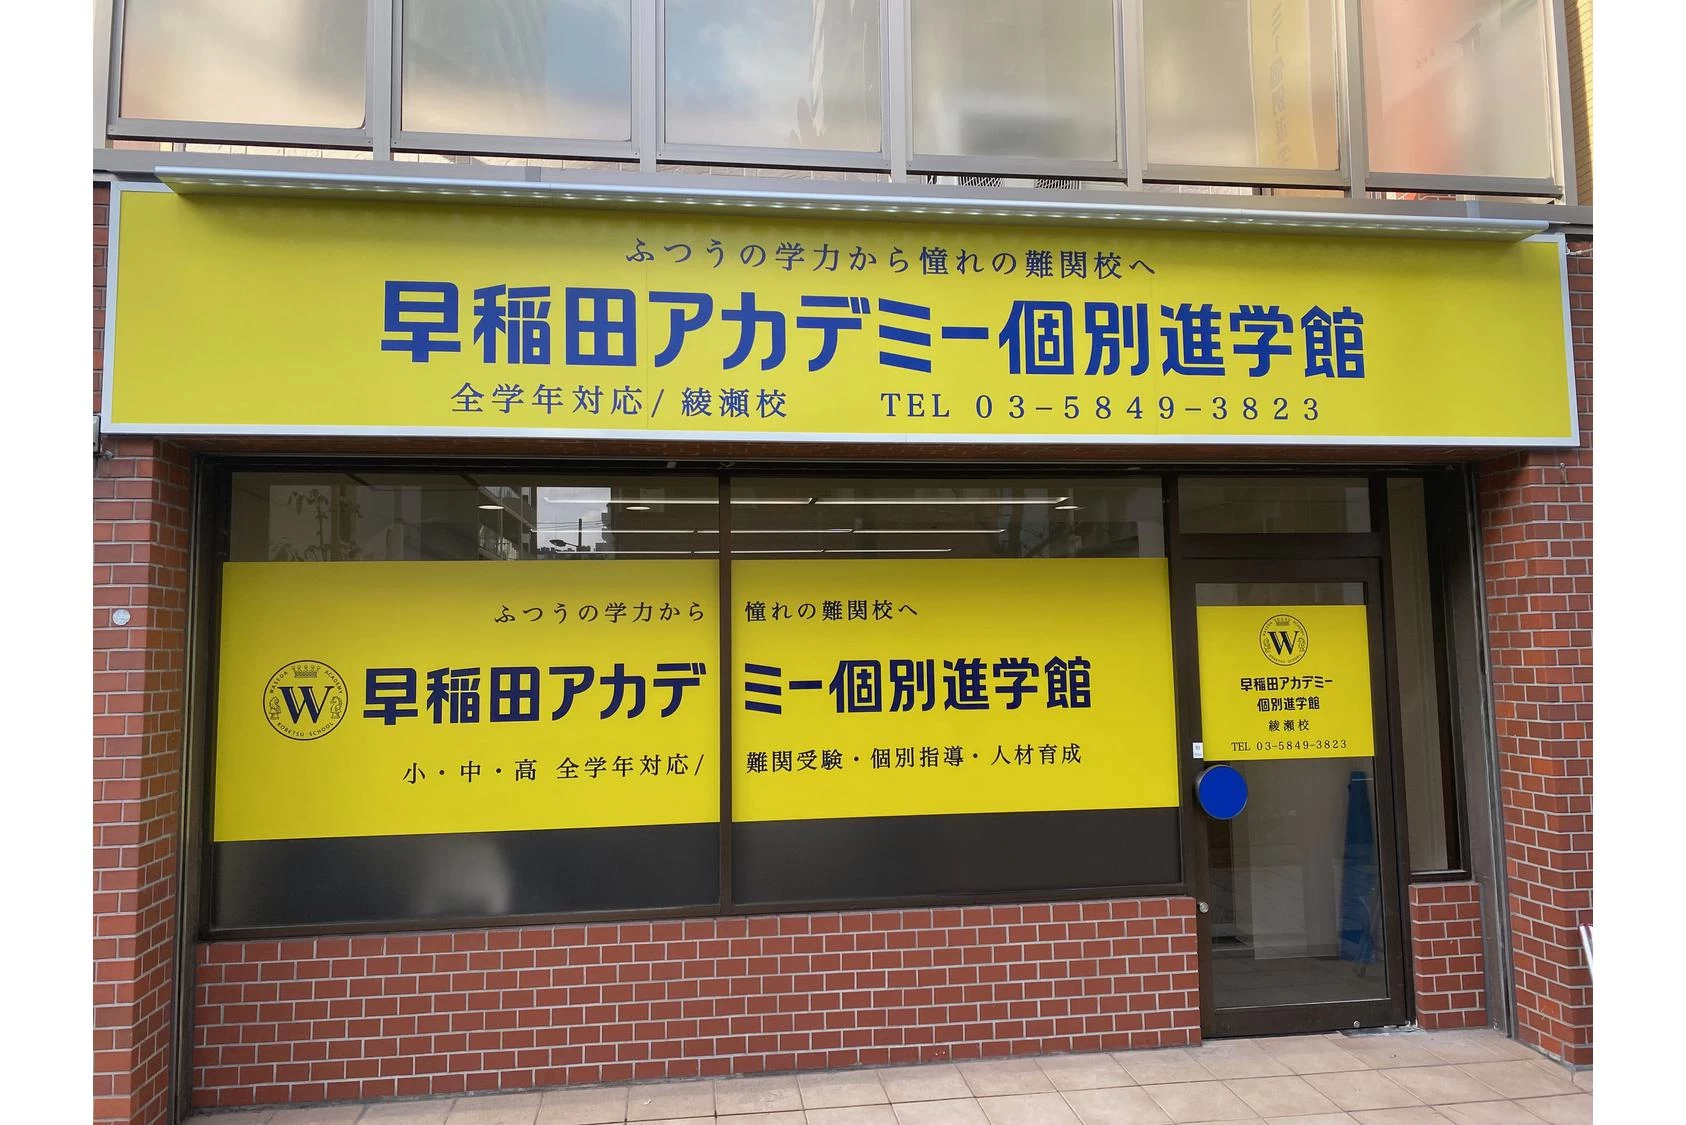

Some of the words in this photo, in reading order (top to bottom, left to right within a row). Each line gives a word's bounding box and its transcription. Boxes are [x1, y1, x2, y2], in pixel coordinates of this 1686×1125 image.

[625, 238, 1157, 280] ふつうの学力から憧れの難関校へ
[381, 280, 1366, 379] 早稲田アカデミー個別進学館
[681, 387, 788, 419] 綾瀬校
[880, 392, 951, 419] TEL
[975, 394, 1320, 421] 03-5849-3823
[494, 601, 706, 625] ふつうの学力から
[744, 599, 919, 623] 憧れの難関校へ
[362, 661, 707, 726] 早稲田アカデ
[744, 655, 1092, 716] ミー個別進学館
[1240, 675, 1333, 692] 早稲田アカデミー
[277, 685, 335, 724] W
[1256, 696, 1321, 713] 個別進学館
[1268, 718, 1311, 732] 綾瀬校
[1231, 741, 1251, 752] TEL
[1256, 739, 1348, 751] 03-5849-3823
[402, 758, 539, 785] 小・中・高
[746, 743, 1083, 774] 難関受験・個別指導・人材育成
